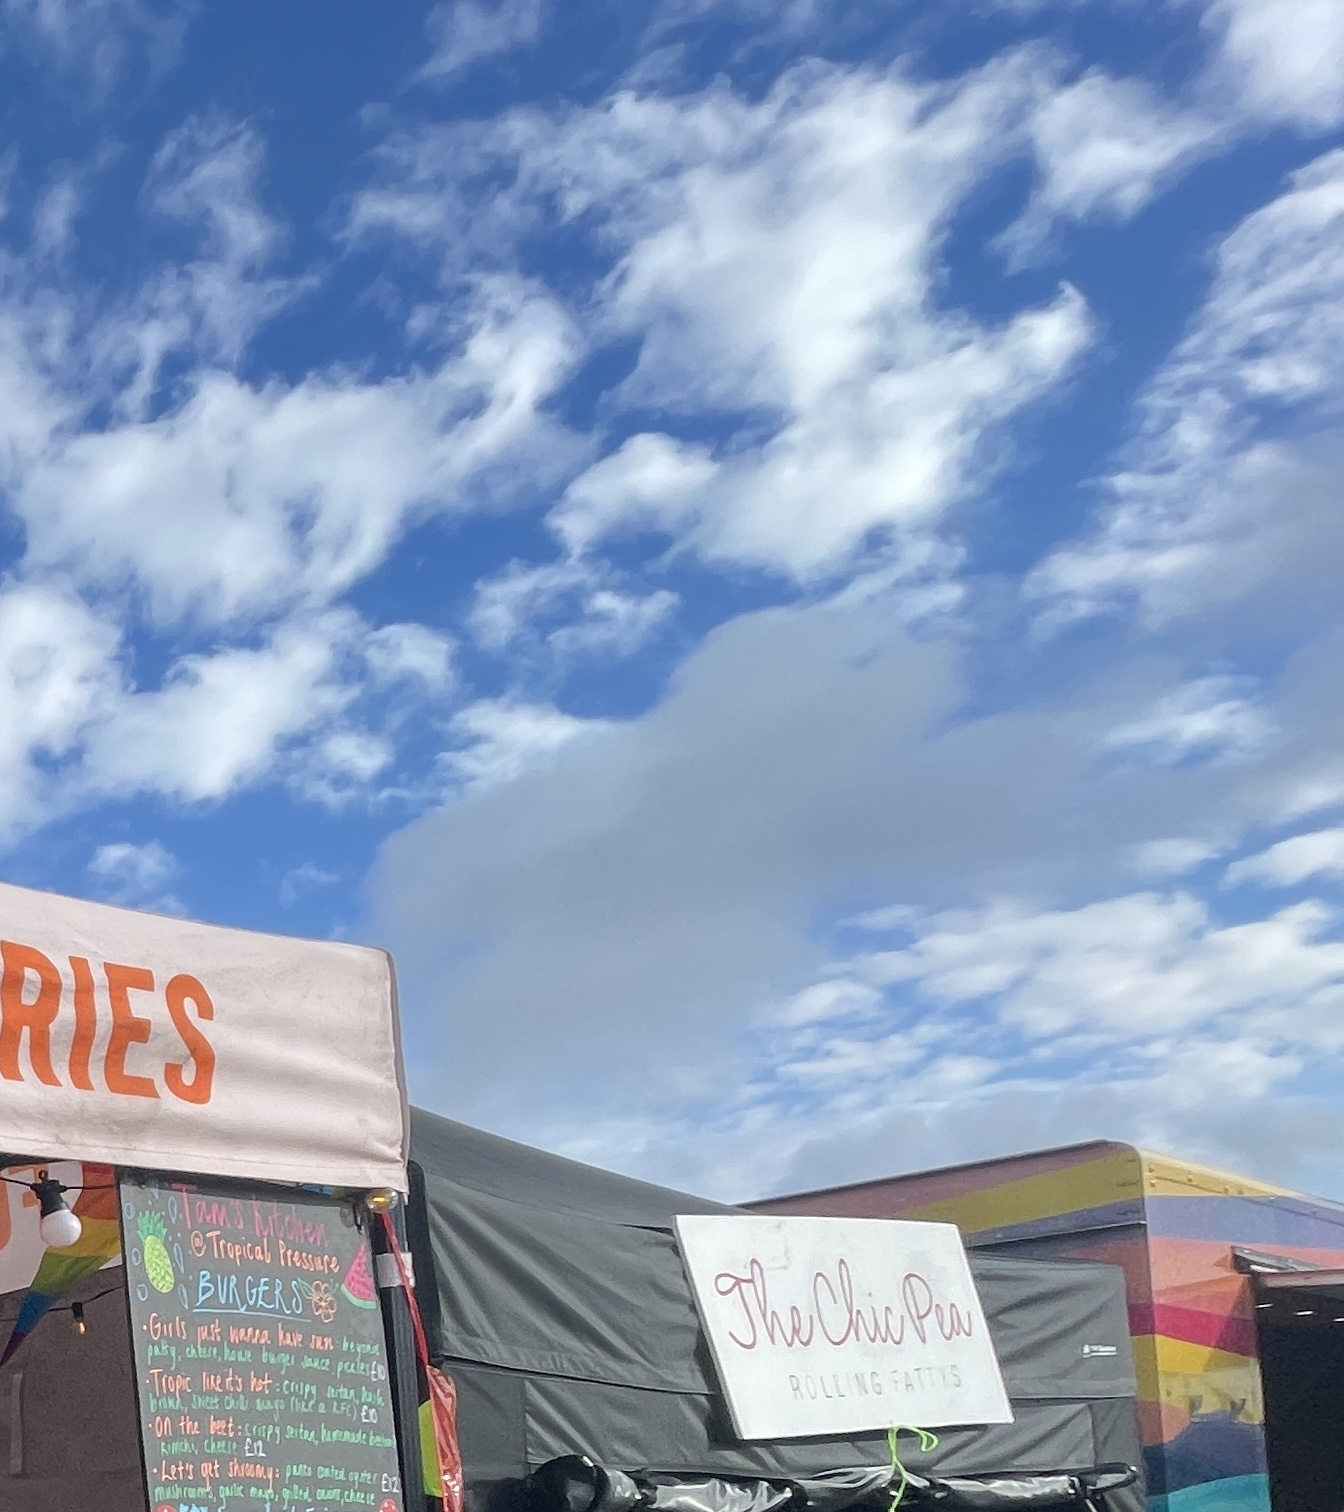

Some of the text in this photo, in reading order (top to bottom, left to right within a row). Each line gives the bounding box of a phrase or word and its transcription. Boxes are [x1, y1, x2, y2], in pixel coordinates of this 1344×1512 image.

[714, 1258, 972, 1349] The Chic Pea
[790, 1371, 882, 1400] ROLLING
